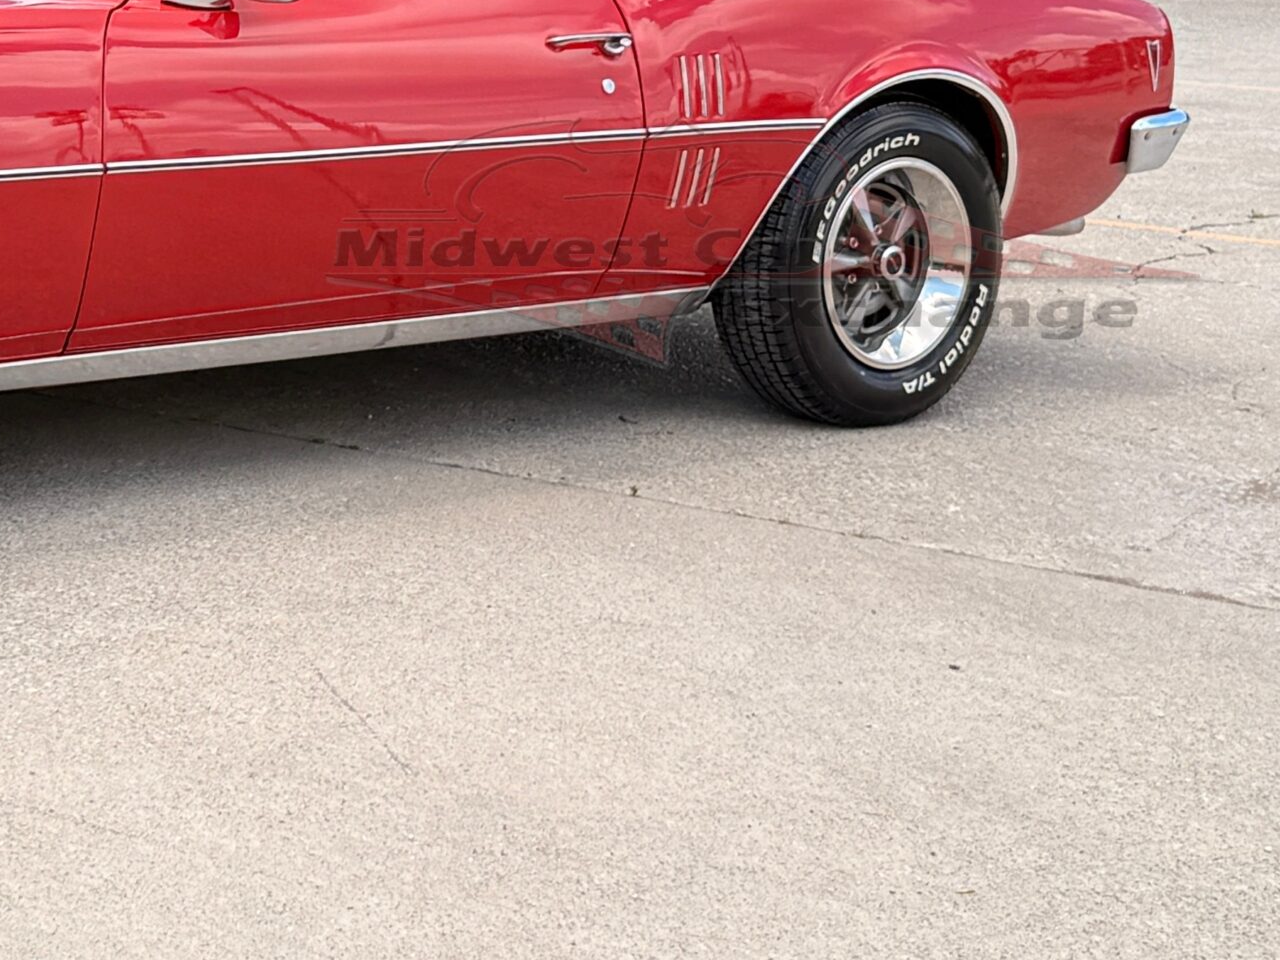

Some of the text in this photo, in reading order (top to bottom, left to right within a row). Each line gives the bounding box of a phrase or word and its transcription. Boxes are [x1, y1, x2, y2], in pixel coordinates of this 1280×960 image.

[812, 133, 920, 264] BFGoodrich
[902, 283, 988, 394] Radial T/A
